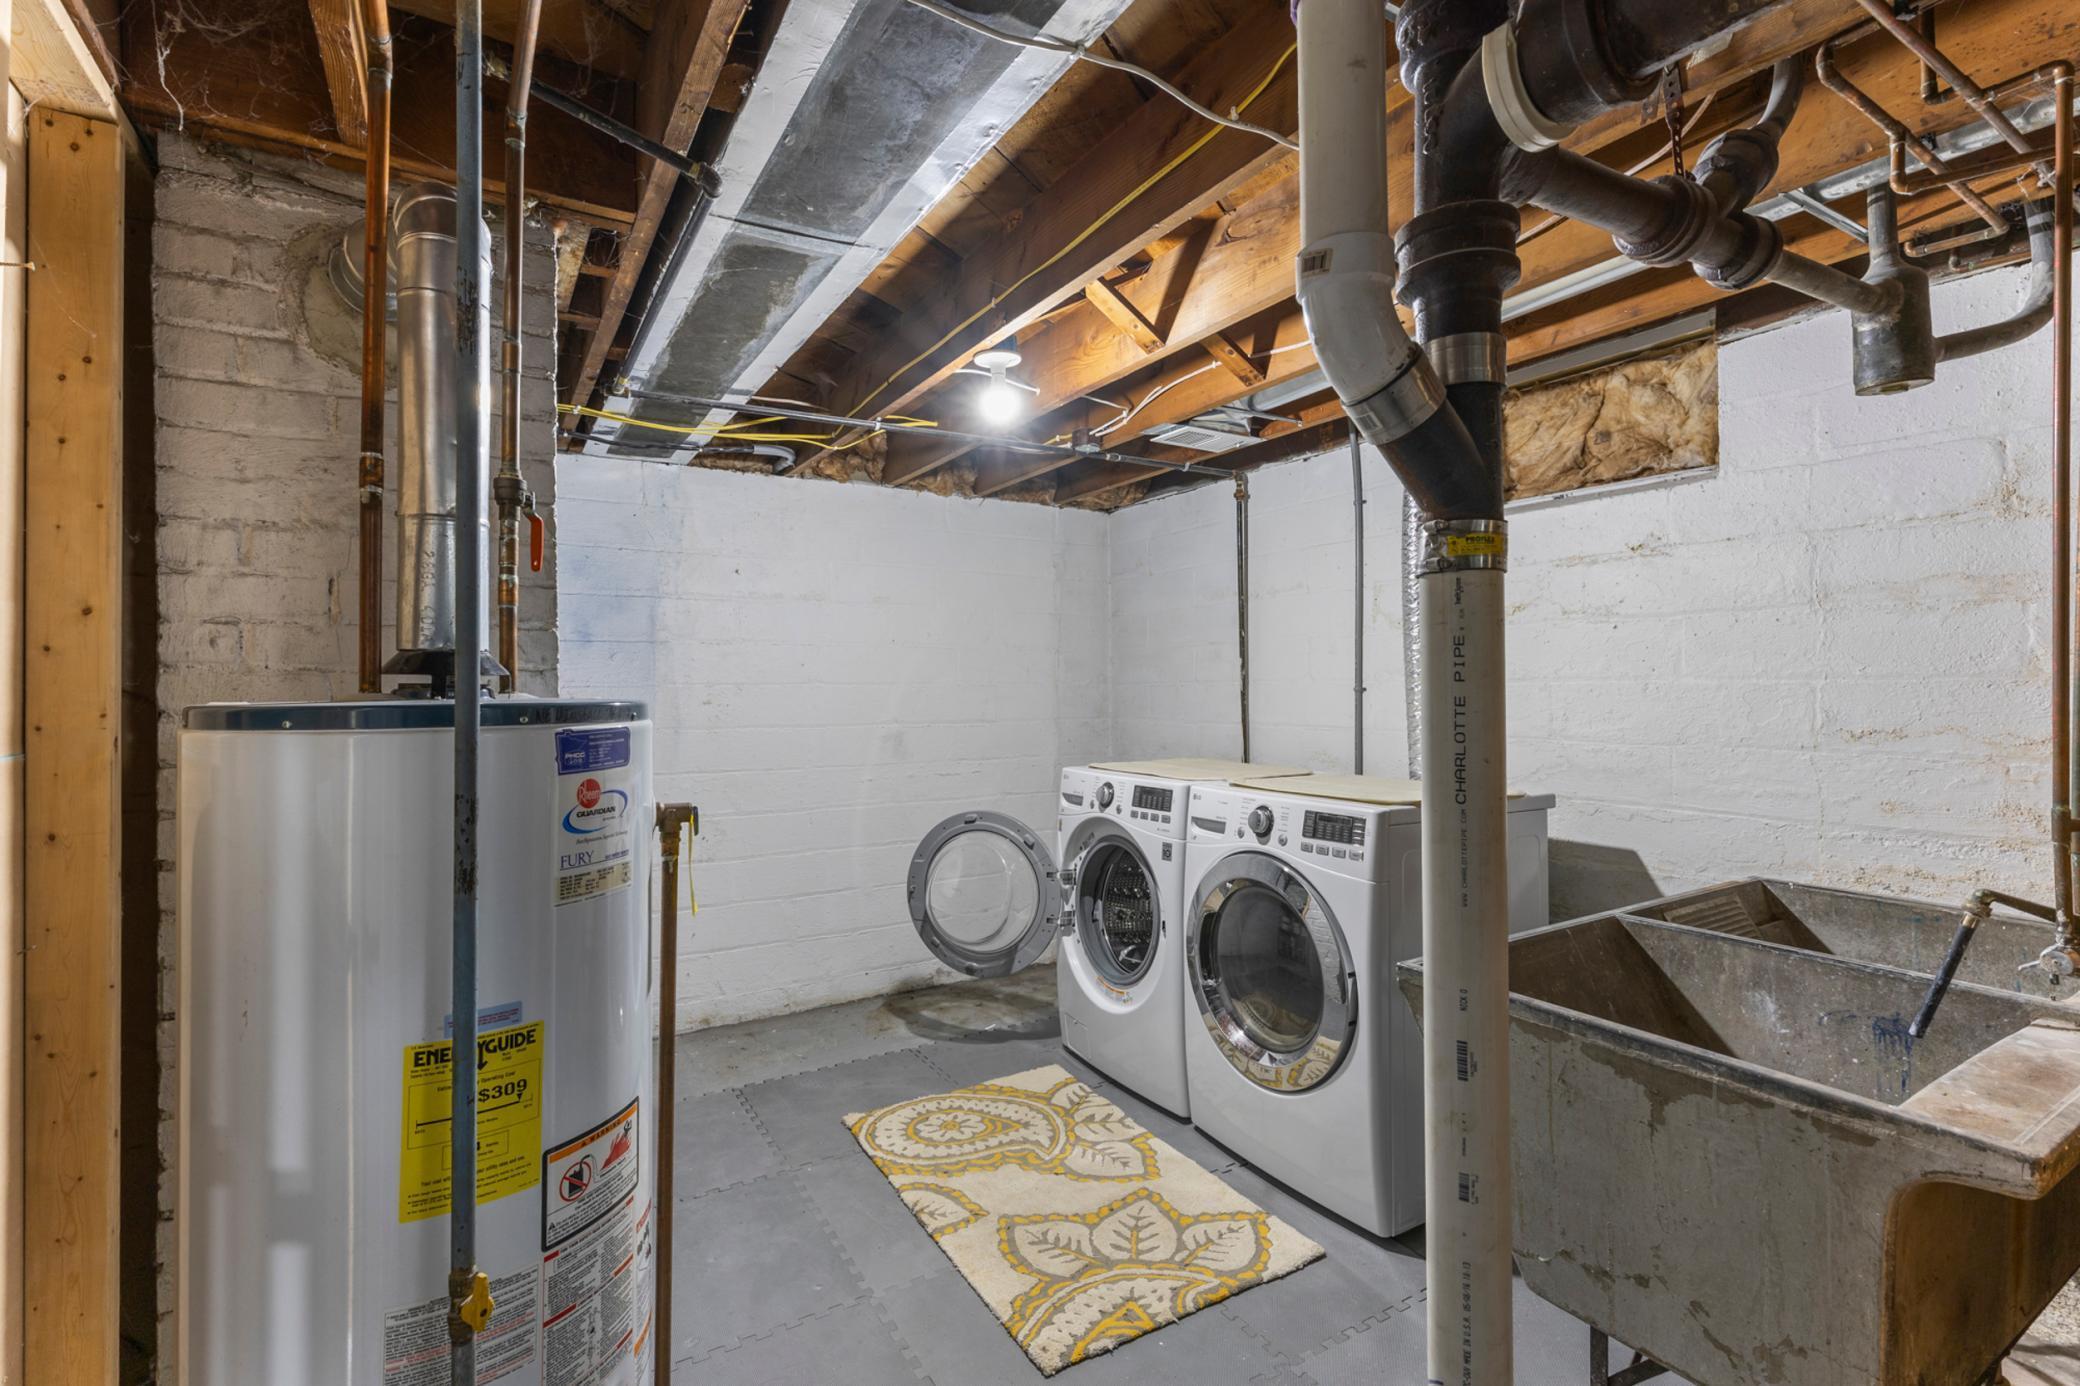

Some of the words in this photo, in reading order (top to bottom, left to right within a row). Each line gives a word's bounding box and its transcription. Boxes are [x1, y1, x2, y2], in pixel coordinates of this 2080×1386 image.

[1453, 635, 1466, 683] PIPE
[1453, 695, 1467, 805] CHARLOTTE
[576, 806, 616, 819] GUARDIAN
[560, 850, 595, 869] FURY
[413, 1028, 537, 1068] ENEYGUIDE
[478, 1078, 528, 1103] $309
